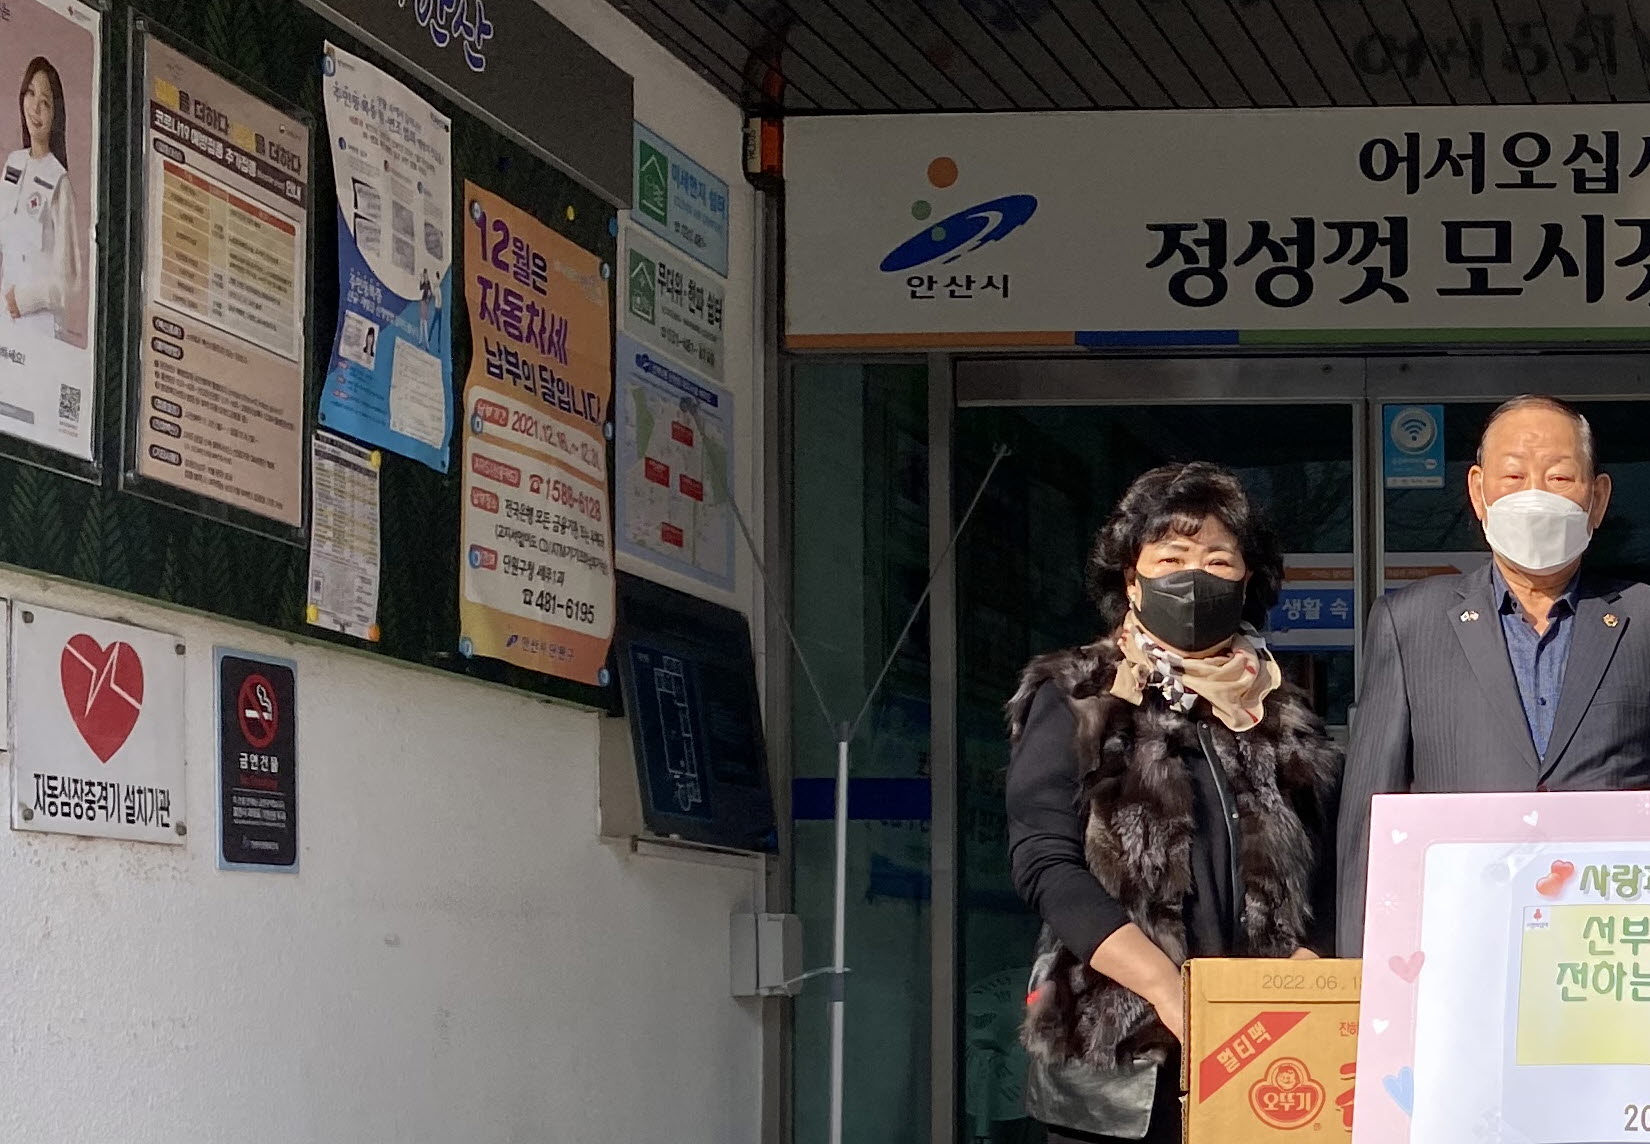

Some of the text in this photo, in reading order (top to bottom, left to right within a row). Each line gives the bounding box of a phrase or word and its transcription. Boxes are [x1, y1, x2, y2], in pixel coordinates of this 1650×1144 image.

[907, 274, 1010, 299] 안산시
[1146, 215, 1409, 308] 정성껏
[477, 275, 568, 365] 자동차세
[484, 336, 537, 396] 납부의
[539, 363, 601, 425] 달입니다
[1282, 598, 1348, 620] 생활 속
[33, 773, 171, 828] 자동심장충격기 설치기관
[1216, 1021, 1271, 1073] 멀티팩
[1264, 1092, 1311, 1111] 오뚜기
